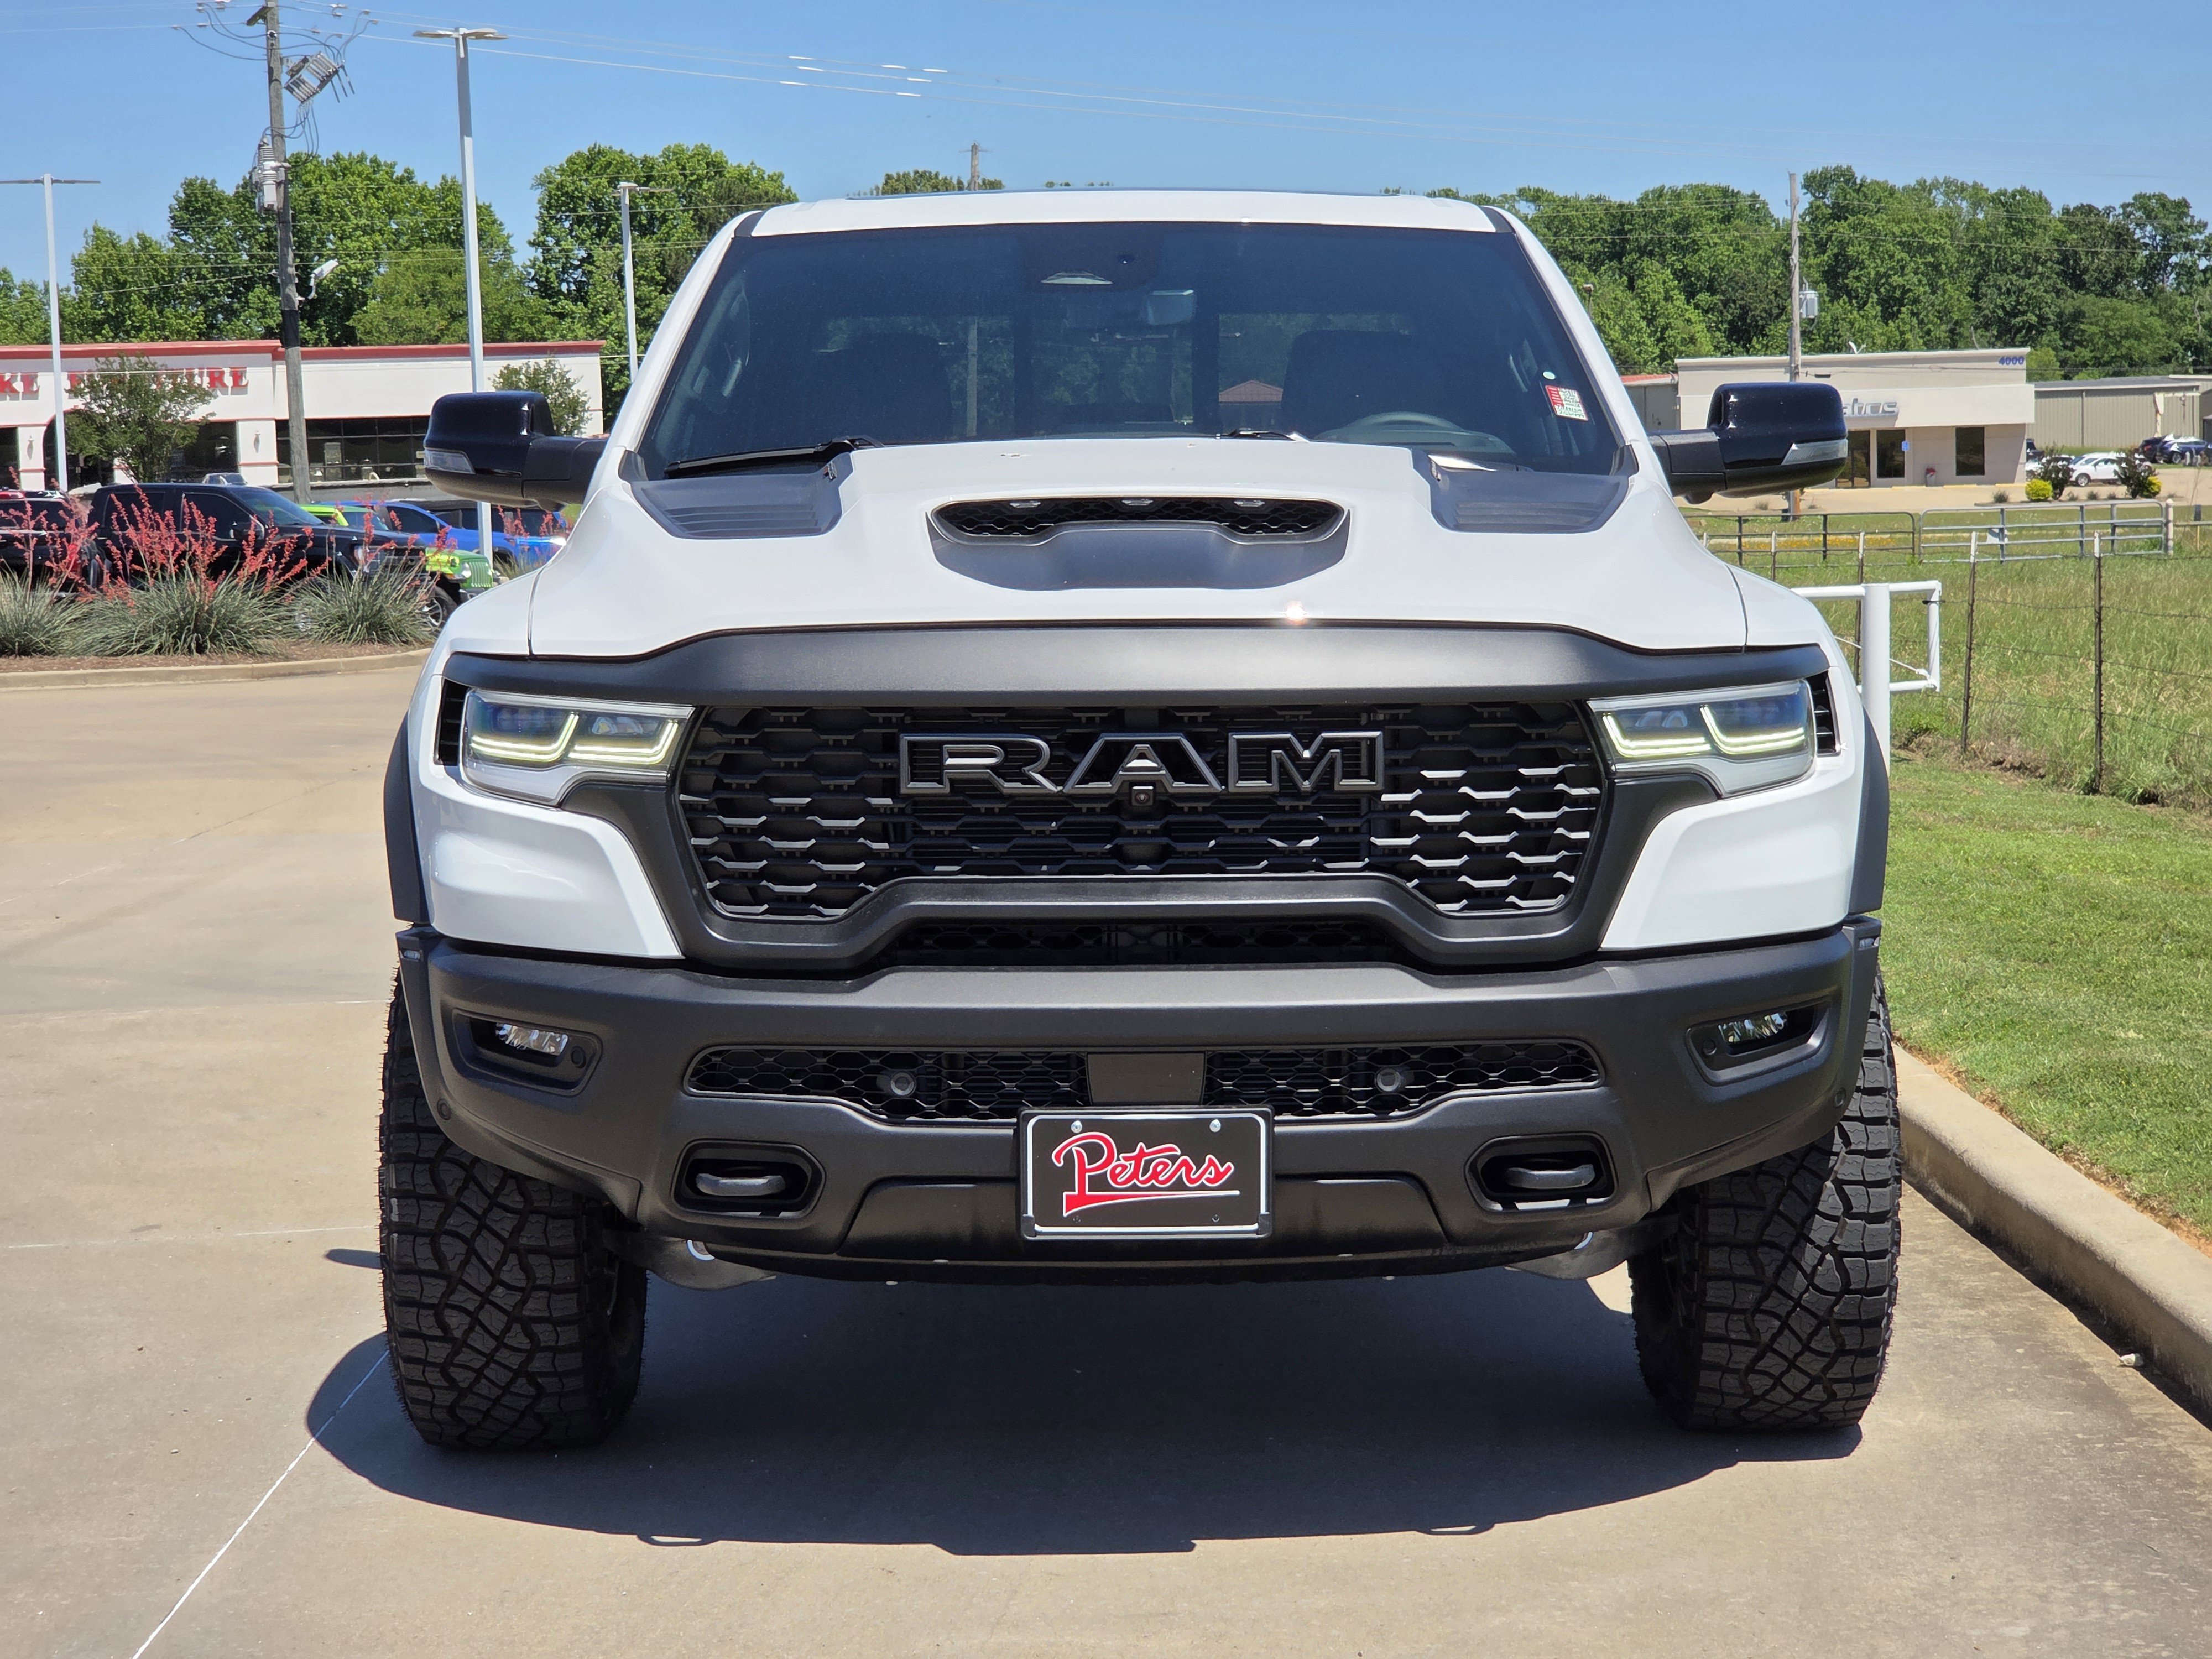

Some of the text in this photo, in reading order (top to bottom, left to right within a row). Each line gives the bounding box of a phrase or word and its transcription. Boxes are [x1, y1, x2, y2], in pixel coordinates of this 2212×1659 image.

[1999, 356, 2025, 366] 4000
[899, 732, 1384, 795] RAM
[1052, 1131, 1239, 1216] Peters
